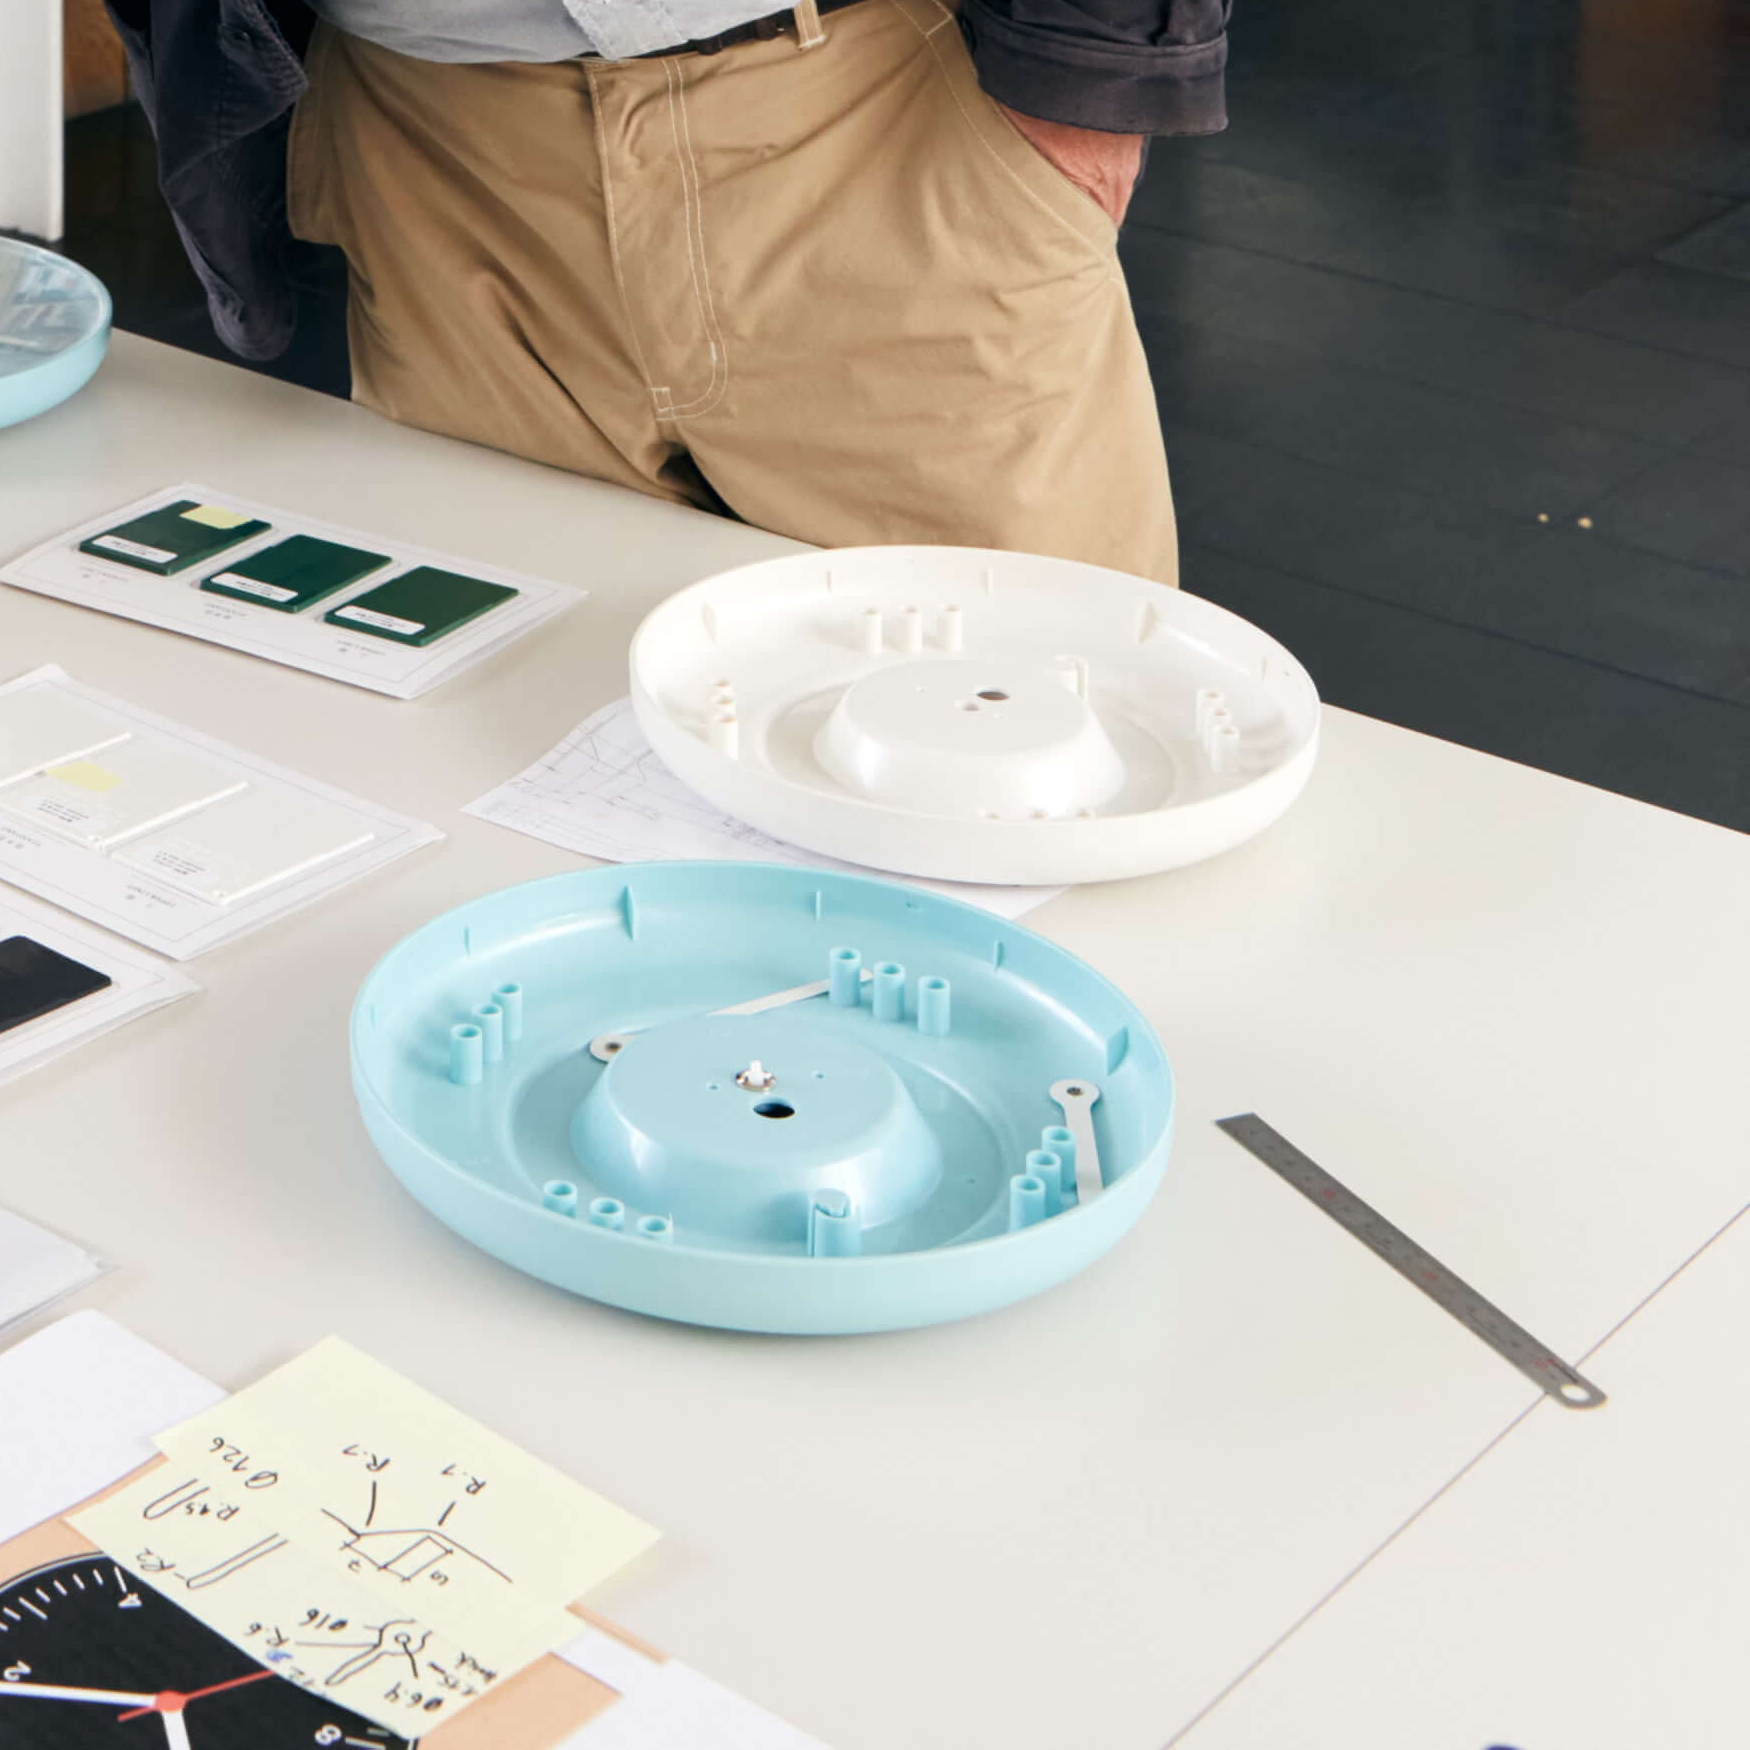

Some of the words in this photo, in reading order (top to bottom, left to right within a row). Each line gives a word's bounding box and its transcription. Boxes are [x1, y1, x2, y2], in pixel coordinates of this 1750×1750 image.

[118, 1591, 143, 1608] 4
[2, 1659, 33, 1682] 2
[313, 1722, 343, 1747] 8
